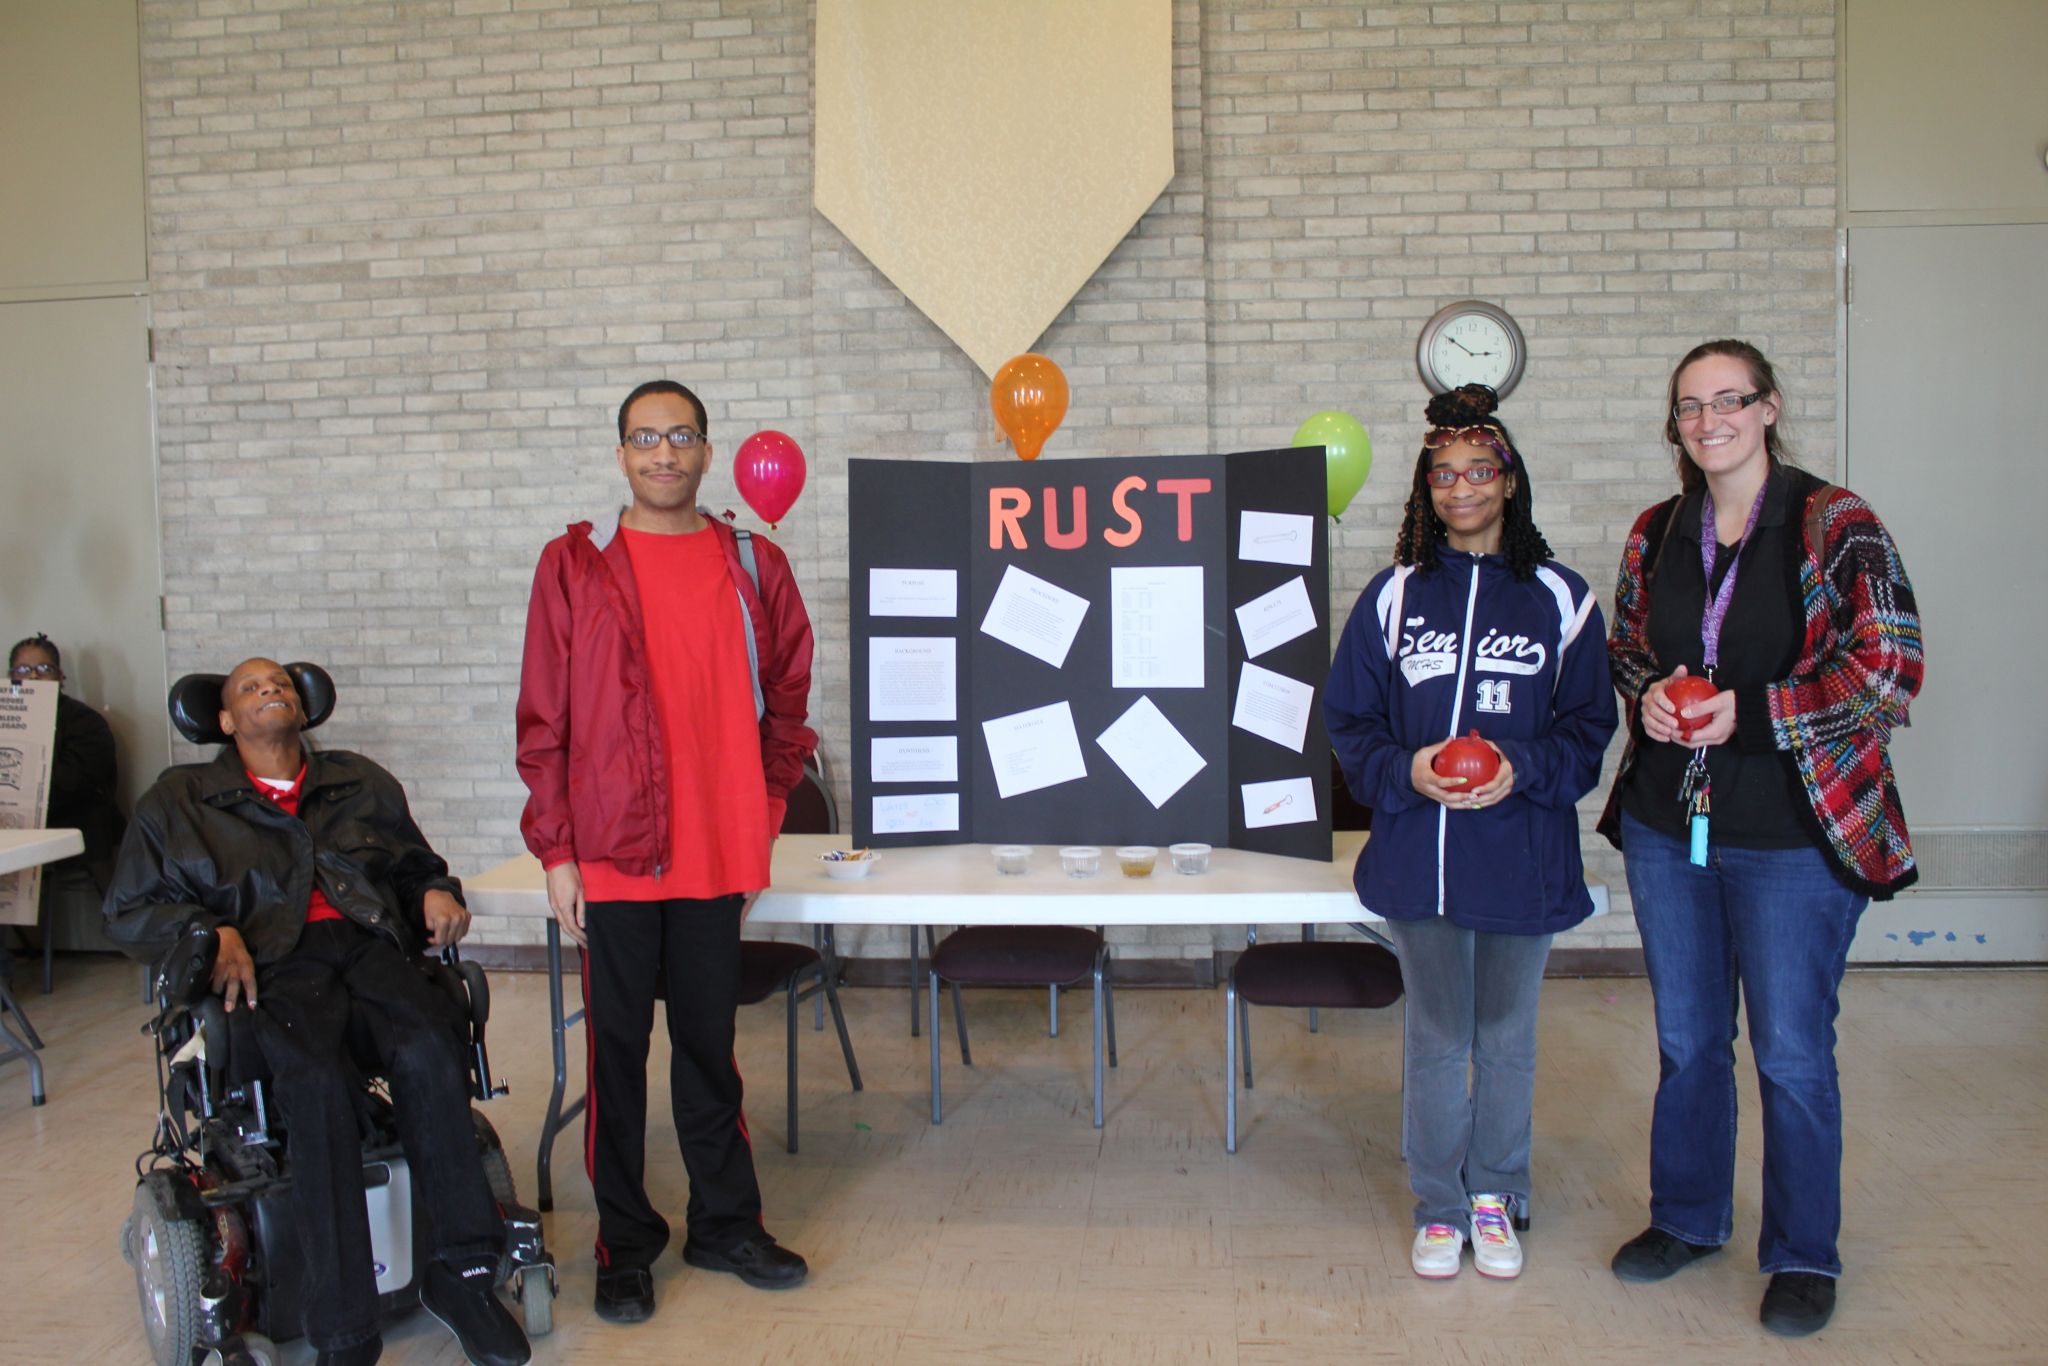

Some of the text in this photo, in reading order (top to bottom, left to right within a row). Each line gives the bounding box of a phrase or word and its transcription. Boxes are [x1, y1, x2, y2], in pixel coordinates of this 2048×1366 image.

[1468, 323, 1478, 333] 12
[989, 475, 1212, 550] RUST
[1476, 679, 1511, 714] 11
